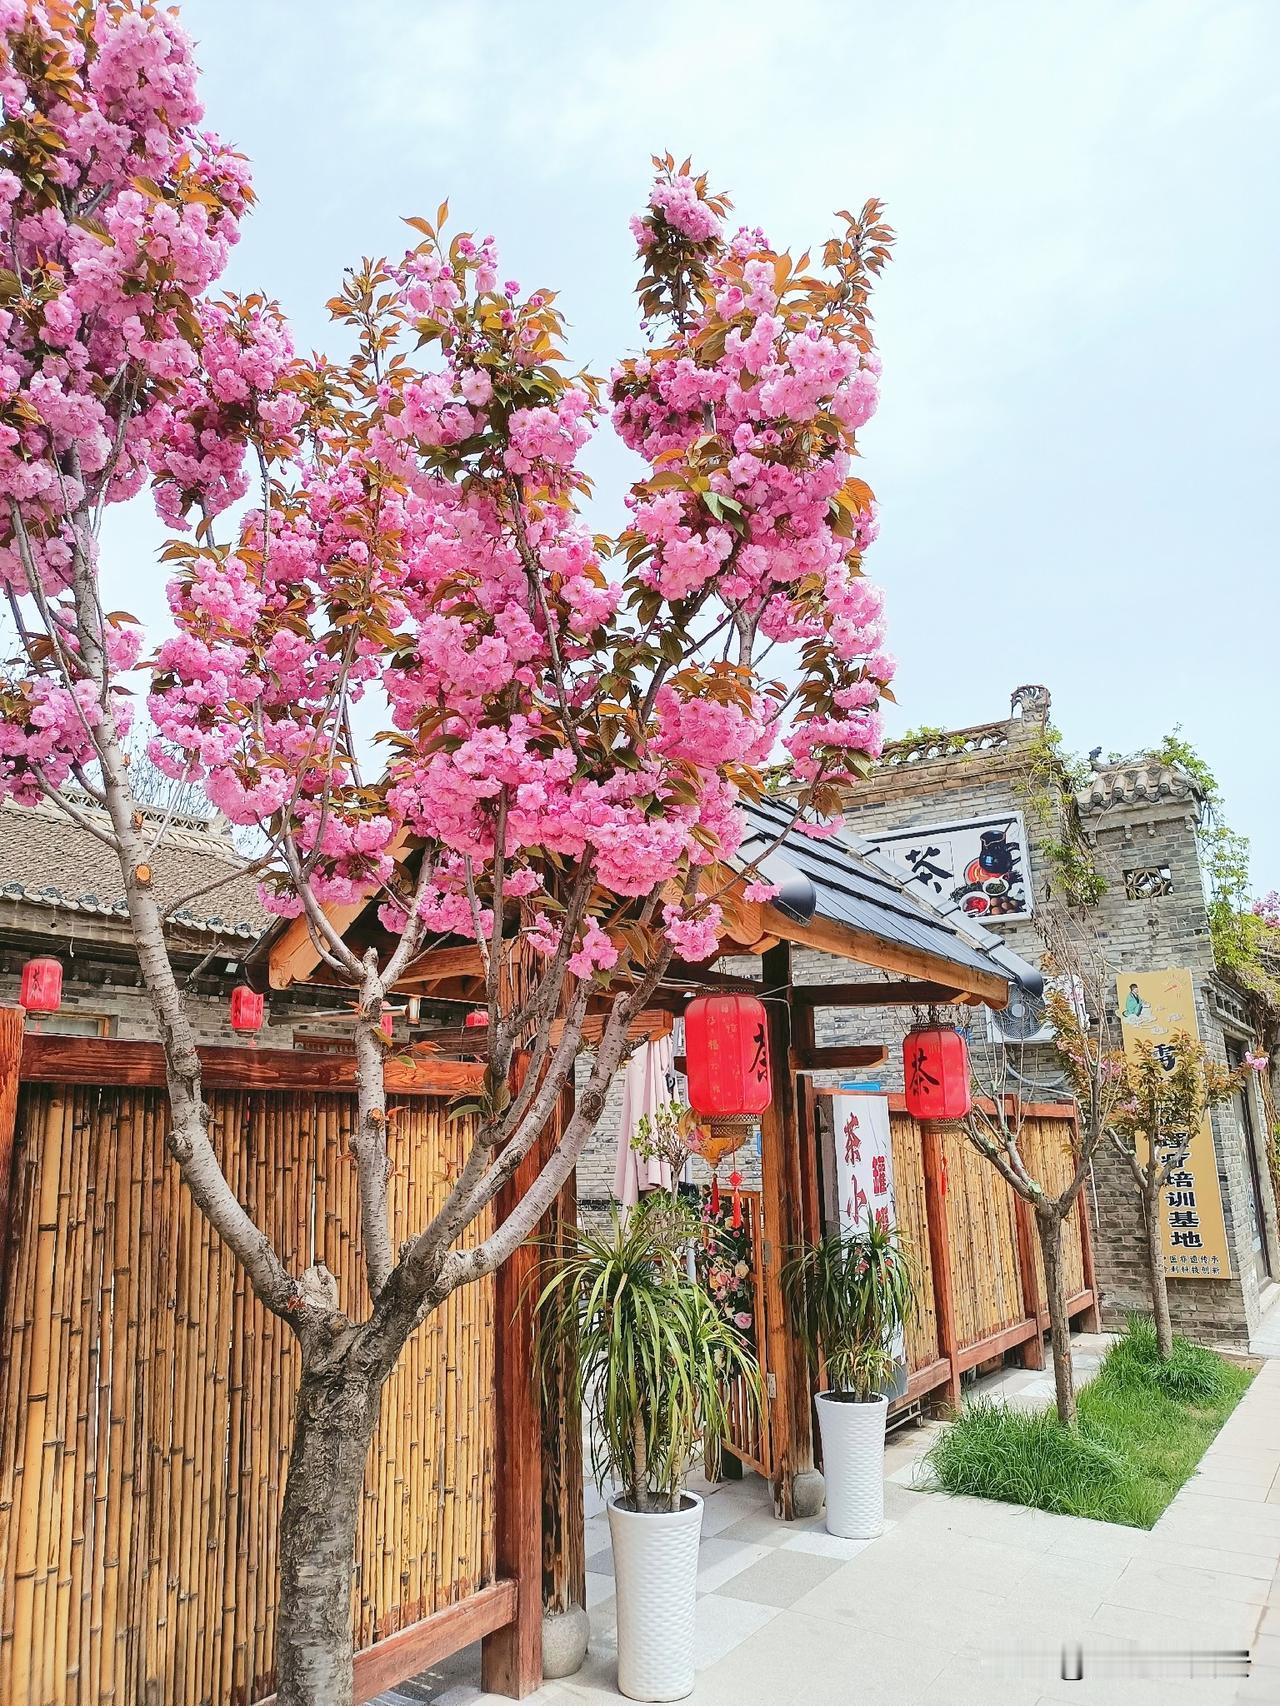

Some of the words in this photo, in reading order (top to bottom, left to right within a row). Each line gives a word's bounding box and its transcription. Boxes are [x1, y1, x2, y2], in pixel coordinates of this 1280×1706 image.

[904, 846, 954, 894] 茶
[909, 1047, 940, 1097] 茶
[1163, 1254, 1219, 1264] 医非遗传承
